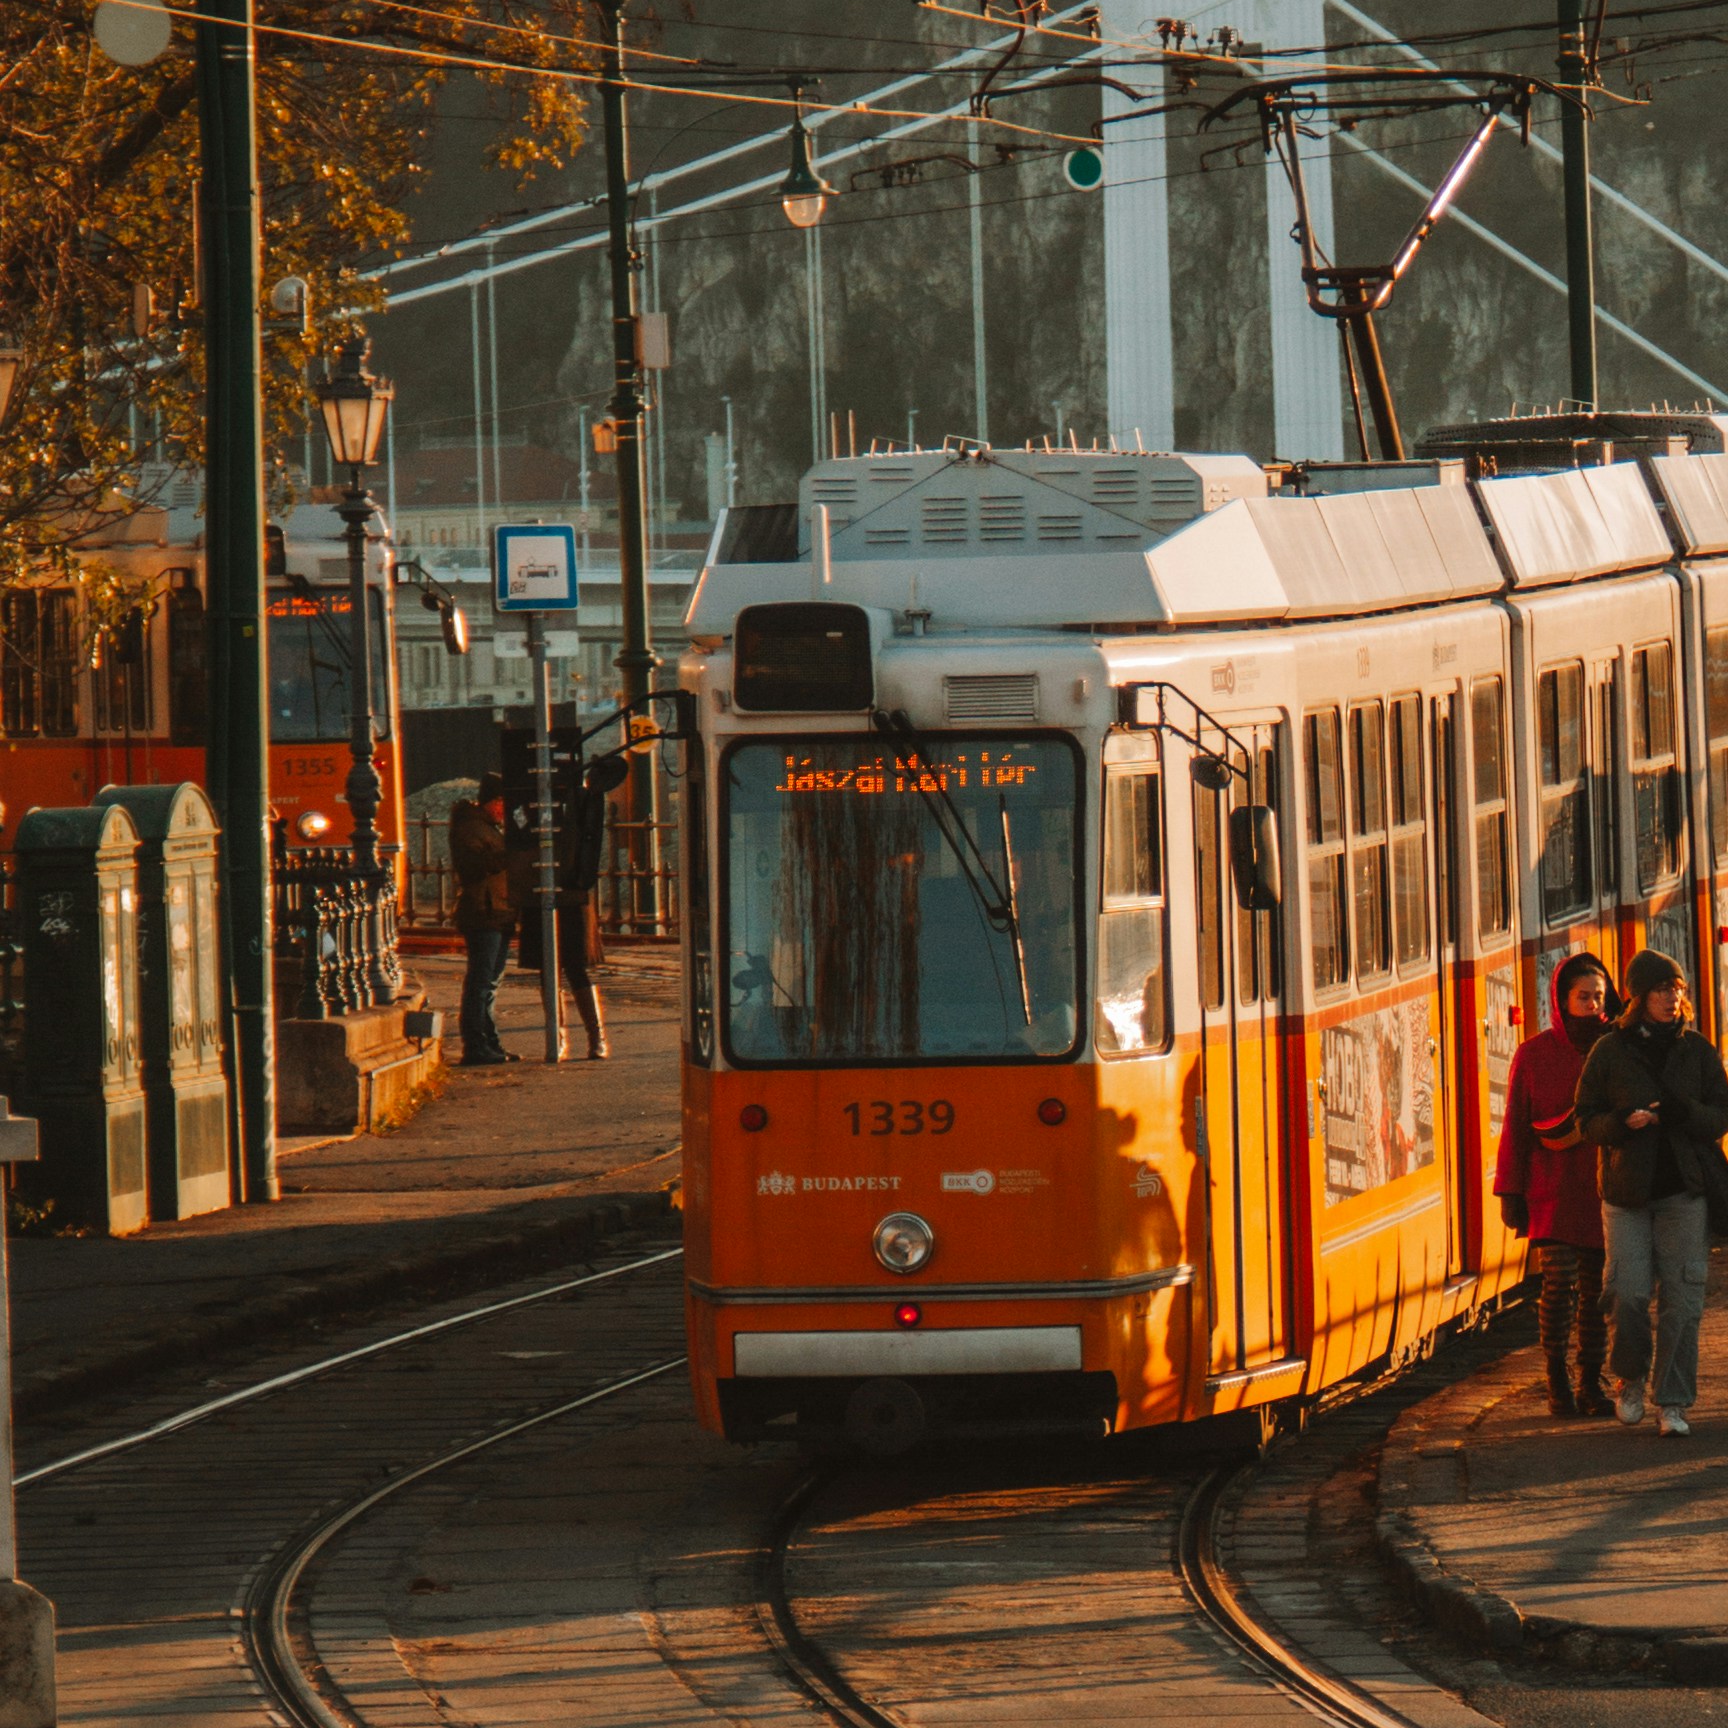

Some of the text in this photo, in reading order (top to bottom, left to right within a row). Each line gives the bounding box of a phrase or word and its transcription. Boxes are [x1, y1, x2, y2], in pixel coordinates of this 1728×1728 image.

[282, 758, 337, 776] 1355
[843, 1099, 955, 1136] 1339
[802, 1176, 902, 1191] BUDAPEST
[947, 1178, 971, 1187] BKK
